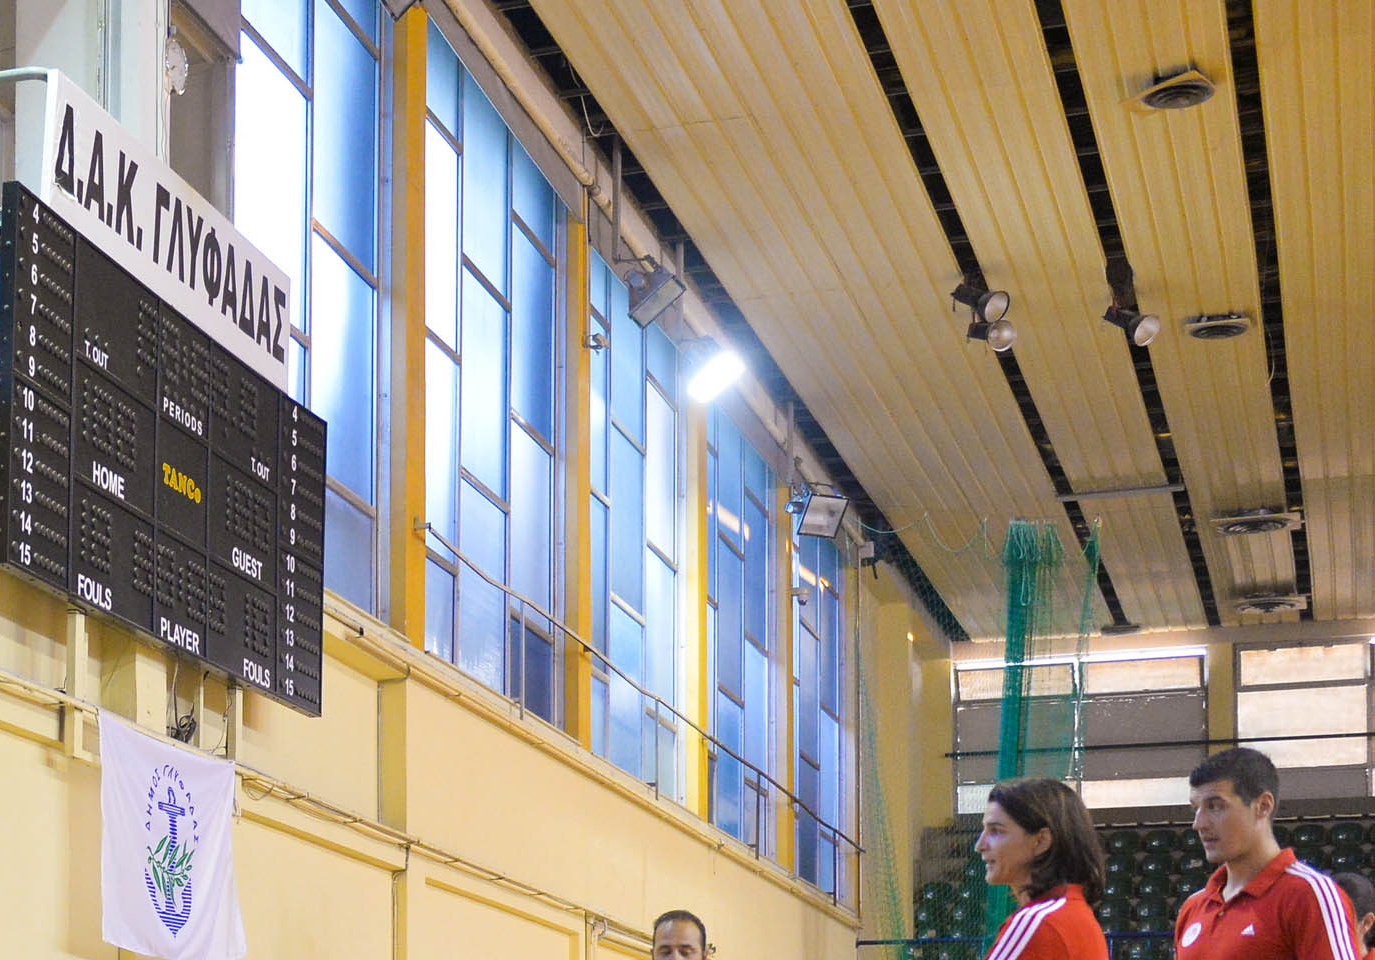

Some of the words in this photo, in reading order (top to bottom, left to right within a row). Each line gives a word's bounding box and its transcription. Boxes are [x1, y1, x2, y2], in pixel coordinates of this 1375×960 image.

[32, 203, 39, 224] 4
[31, 232, 39, 254] 5
[55, 103, 143, 252] Δ.Α.Κ.
[152, 181, 287, 365] ΓΛΥΦΑΔΑΣ
[31, 263, 38, 285] 6
[30, 293, 37, 315] 7
[29, 325, 36, 347] 8
[28, 355, 35, 377] 9
[93, 348, 109, 370] OUT
[22, 386, 34, 411] 10
[163, 396, 203, 436] PERIODS
[292, 405, 298, 422] 4
[22, 418, 34, 443] 11
[291, 429, 297, 446] 5
[21, 449, 33, 474] 12
[257, 463, 270, 482] OUT
[291, 454, 297, 471] 6
[92, 460, 125, 500] HOME
[291, 478, 296, 495] 7
[20, 479, 33, 504] 13
[290, 503, 296, 520] 8
[20, 511, 32, 536] 14
[290, 528, 295, 545] 9
[19, 541, 31, 566] 15
[232, 546, 262, 581] GUEST
[286, 554, 295, 573] 10
[77, 573, 112, 610] FOULS
[285, 578, 294, 598] 11
[285, 603, 294, 623] 12
[160, 616, 200, 655] PLAYER
[285, 628, 294, 647] 13
[243, 658, 270, 689] FOULS
[285, 653, 294, 672] 14
[285, 677, 294, 696] 15
